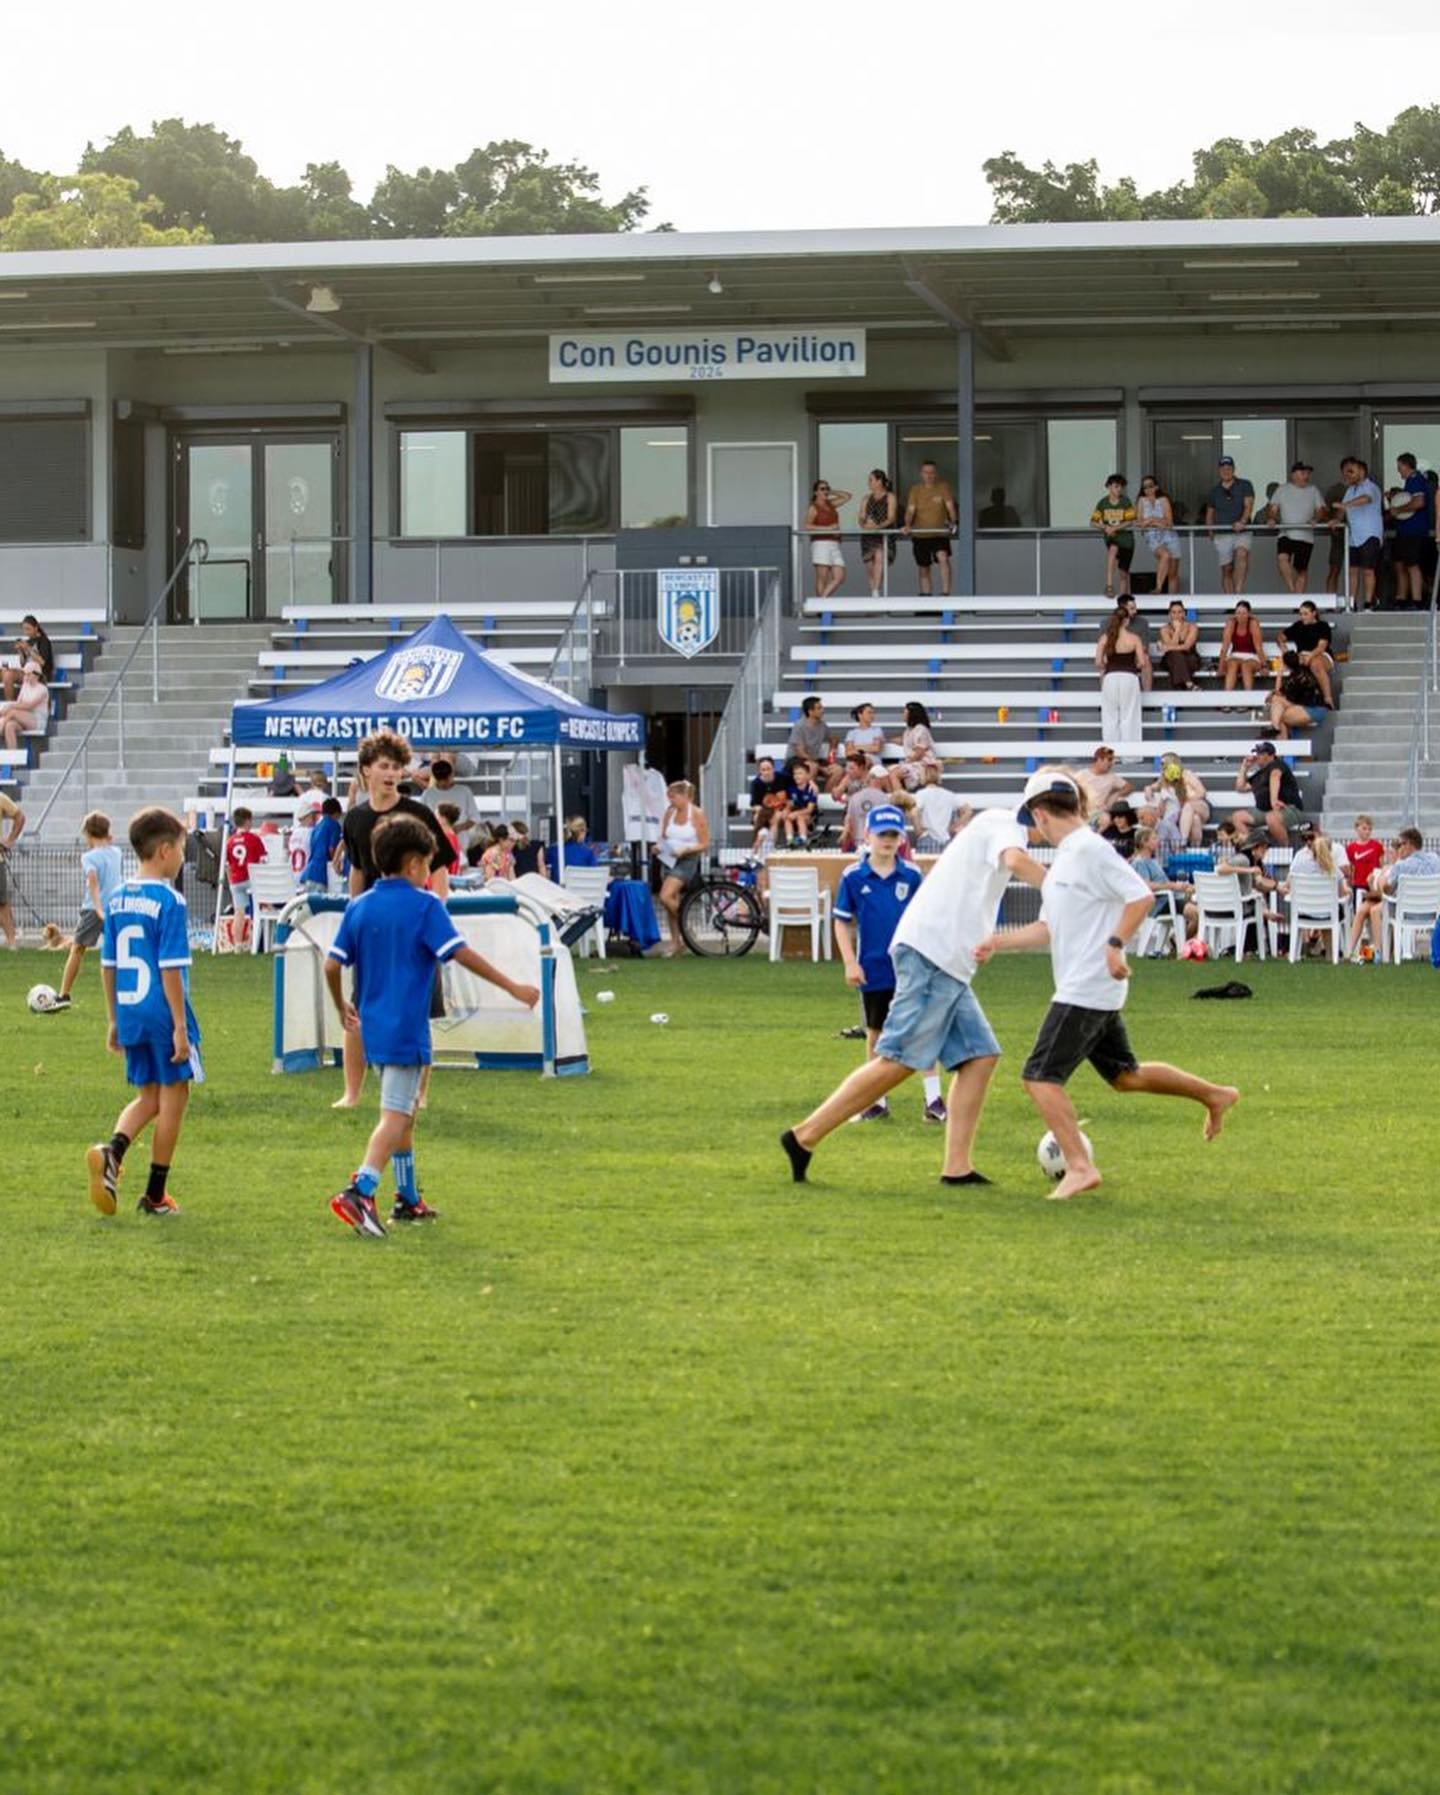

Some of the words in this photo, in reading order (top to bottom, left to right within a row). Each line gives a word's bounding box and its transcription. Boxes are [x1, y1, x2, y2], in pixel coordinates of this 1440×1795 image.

[559, 340, 615, 367] Con
[626, 338, 726, 365] Gounis
[736, 336, 855, 364] Pavilion
[690, 366, 723, 378] 2024
[397, 717, 490, 738] OLYMPIC
[496, 716, 525, 738] FC
[232, 844, 247, 866] 9
[116, 924, 151, 1005] 5
